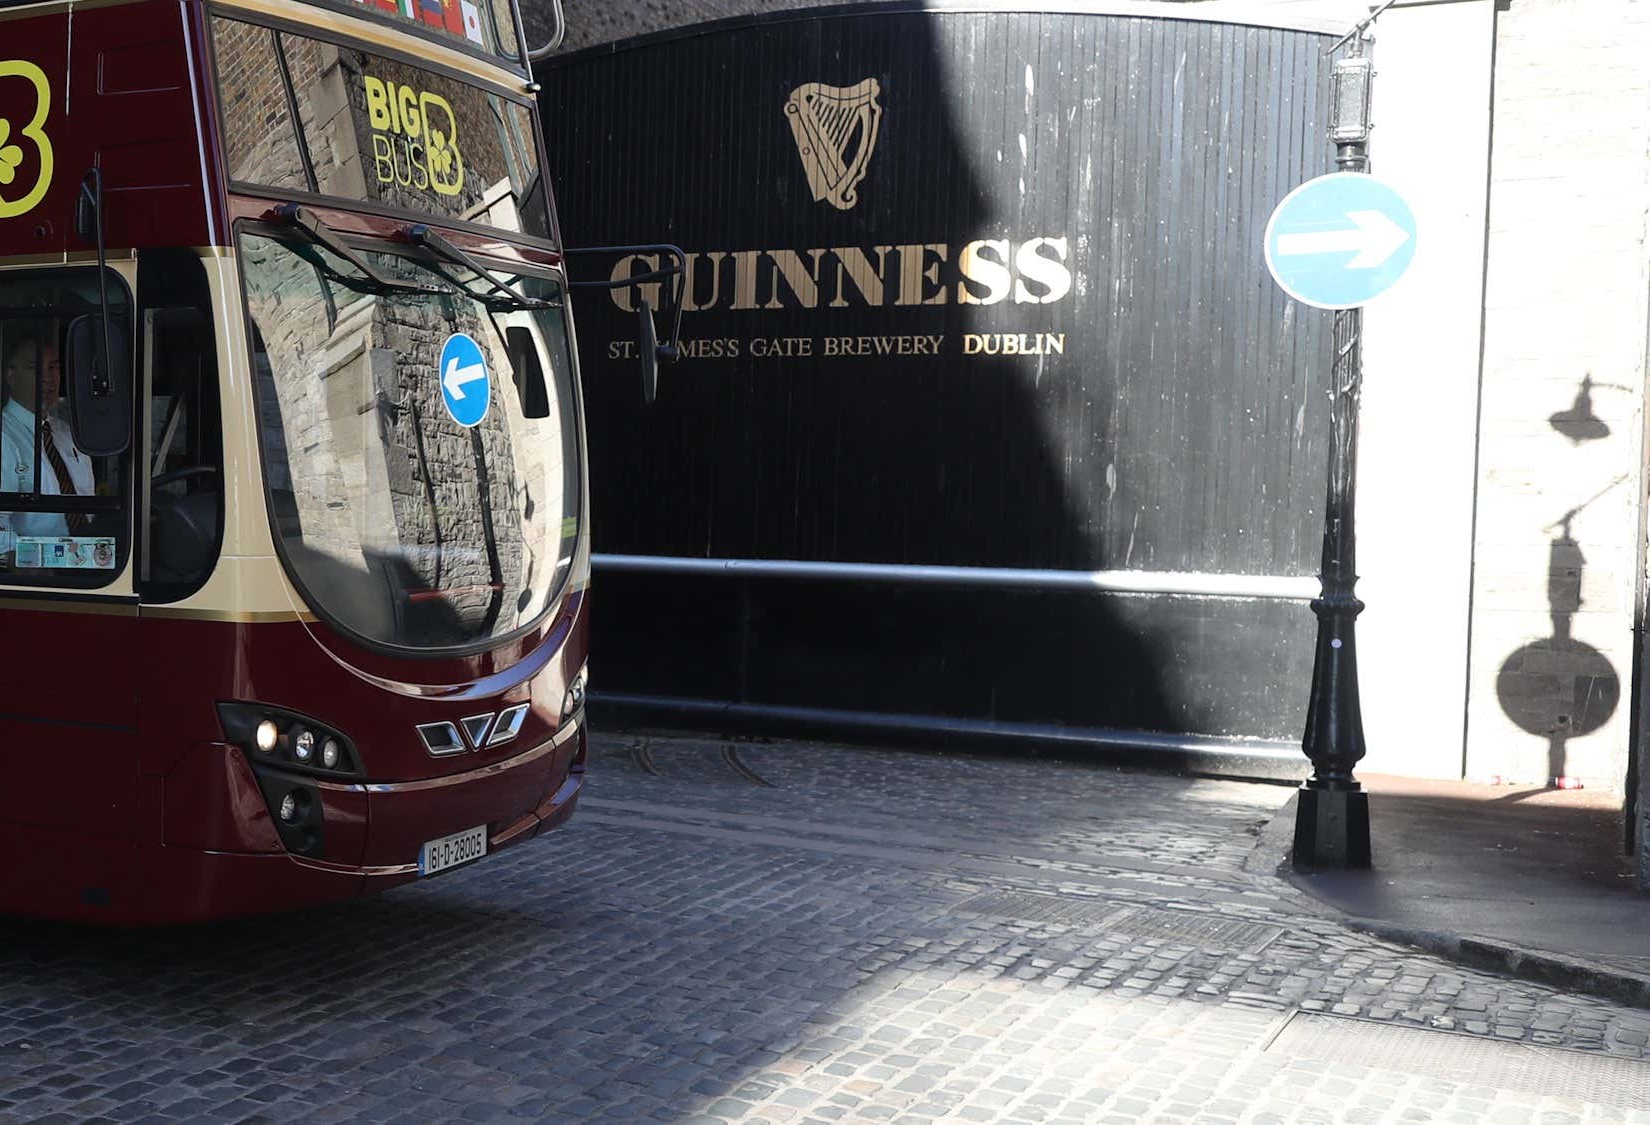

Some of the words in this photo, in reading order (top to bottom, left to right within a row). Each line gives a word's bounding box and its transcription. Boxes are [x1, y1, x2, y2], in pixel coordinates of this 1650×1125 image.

[364, 75, 421, 137] BIG
[372, 134, 428, 190] BUS
[609, 237, 1072, 312] GUINNESS
[608, 341, 640, 359] ST.
[655, 339, 740, 359] MES'S
[750, 338, 813, 357] GATE
[823, 335, 944, 356] BREWERY
[963, 333, 1066, 355] DUBLIN
[429, 834, 482, 871] 161-D-28005
